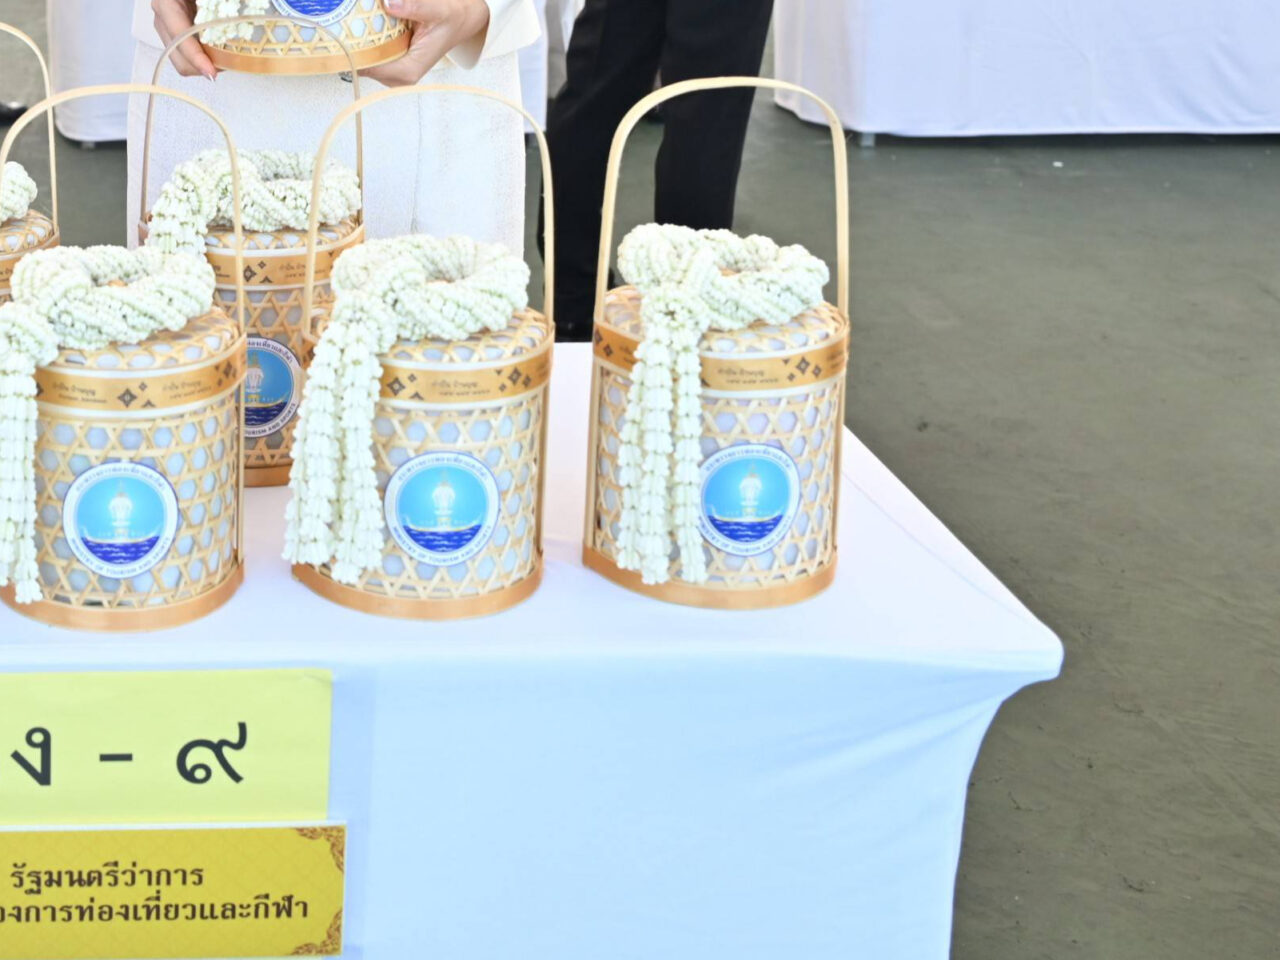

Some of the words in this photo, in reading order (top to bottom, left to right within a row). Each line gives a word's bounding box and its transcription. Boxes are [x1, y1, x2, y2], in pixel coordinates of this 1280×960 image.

[99, 753, 133, 762] -
[176, 722, 247, 784] ๙
[10, 862, 204, 895] รัฐมนตรีว่าการ
